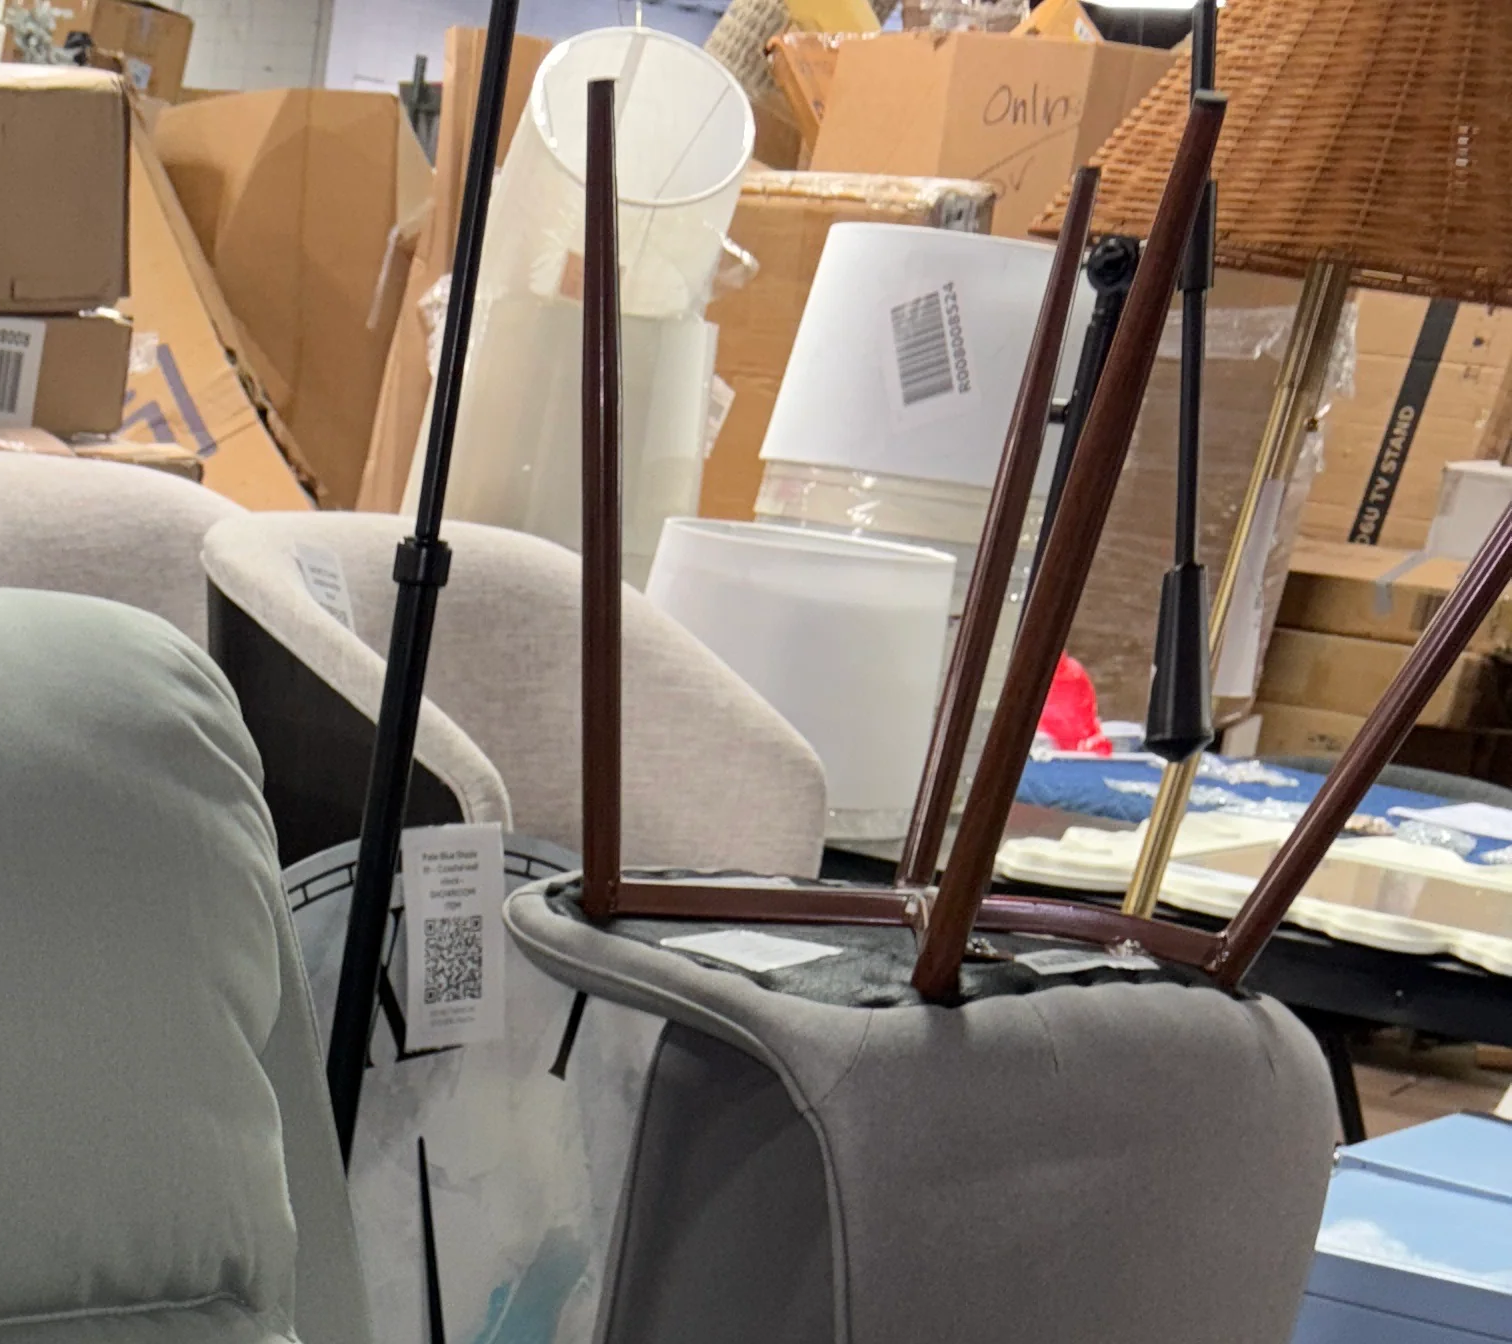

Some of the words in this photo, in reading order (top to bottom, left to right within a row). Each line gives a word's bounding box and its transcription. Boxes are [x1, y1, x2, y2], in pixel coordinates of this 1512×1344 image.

[983, 83, 1082, 127] Onlin
[1368, 476, 1390, 504] TV
[1380, 405, 1415, 475] STAND
